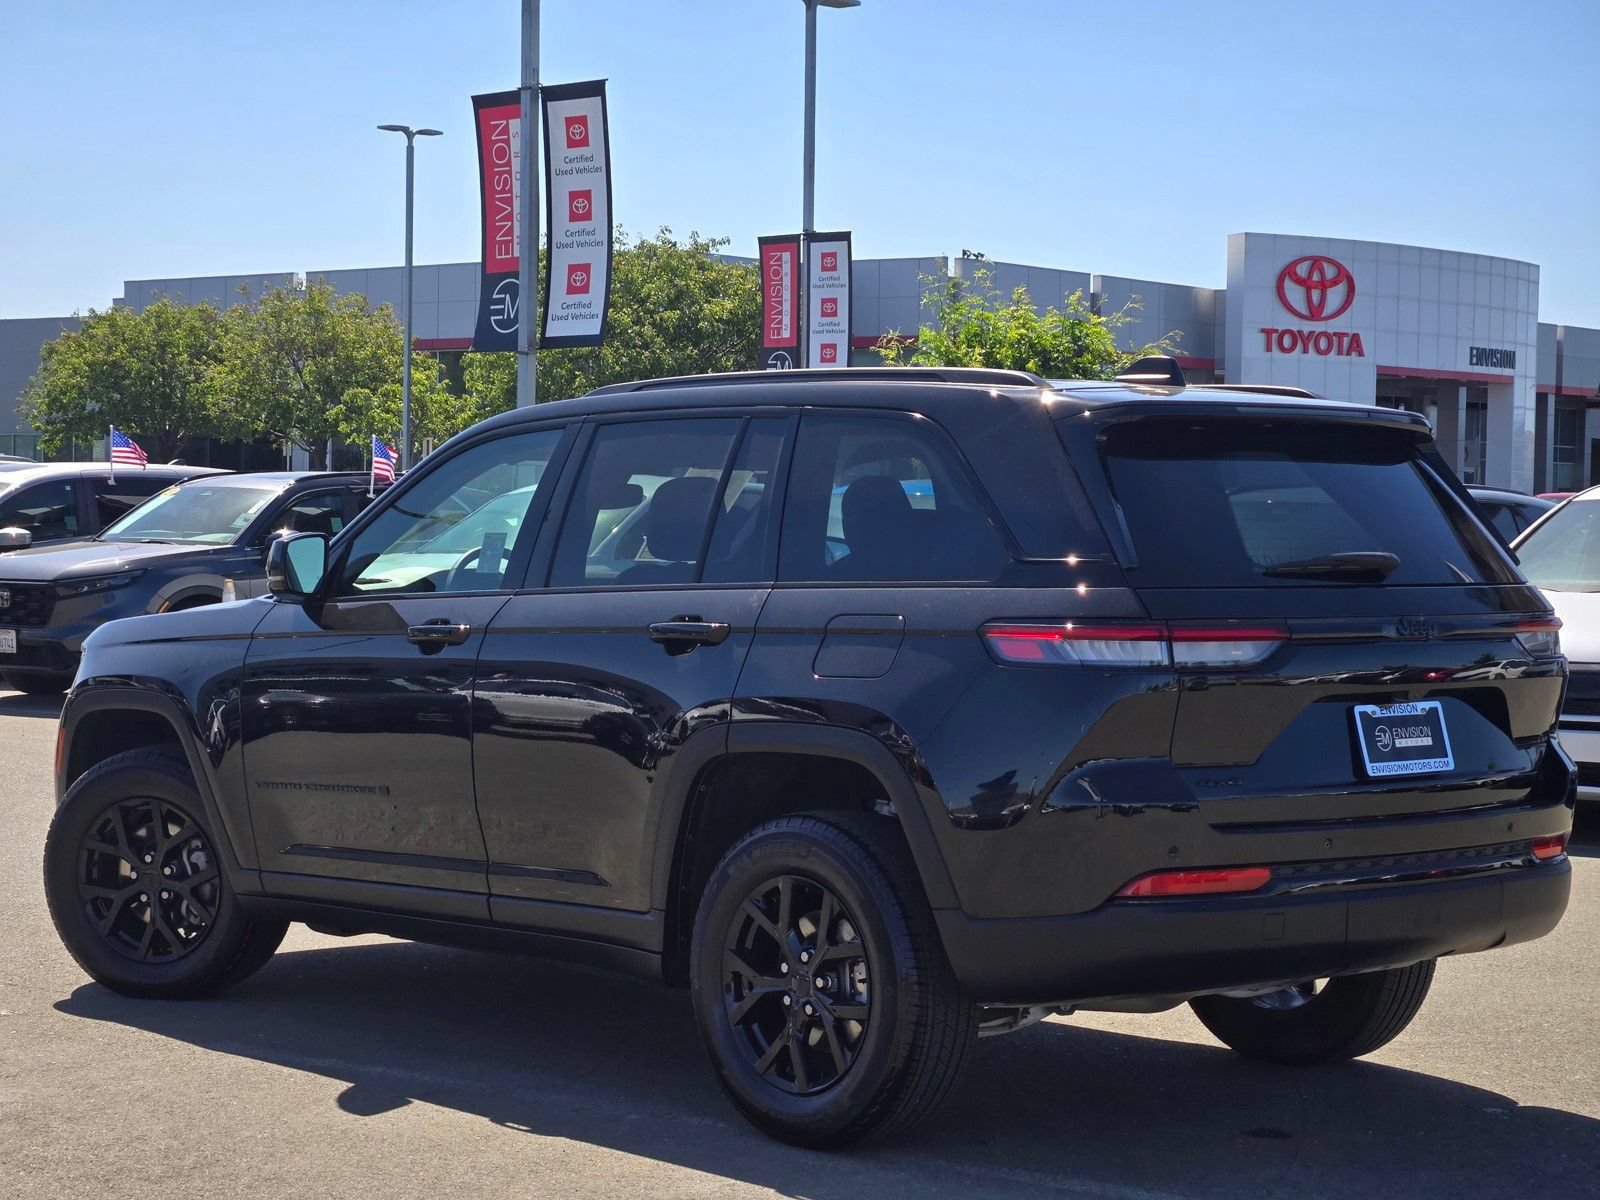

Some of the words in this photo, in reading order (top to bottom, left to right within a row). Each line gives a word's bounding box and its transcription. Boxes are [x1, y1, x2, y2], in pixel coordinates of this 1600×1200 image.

[563, 154, 594, 164] Certified
[554, 167, 574, 176] Used
[574, 165, 603, 175] Vehicles
[490, 120, 512, 259] ENVISION
[564, 228, 596, 238] Certified
[555, 240, 574, 249] Used
[575, 238, 604, 248] Vehicles
[769, 252, 782, 339] ENVISION
[560, 301, 592, 310] Certified
[551, 312, 570, 322] Used
[570, 311, 599, 321] Vehicles
[1260, 328, 1365, 357] TOYOTA
[1469, 346, 1516, 370] ENVISION
[1380, 704, 1419, 715] ENVISION
[1392, 726, 1432, 739] ENVISION
[1371, 760, 1450, 774] ENVISIONMOTORS.COM
